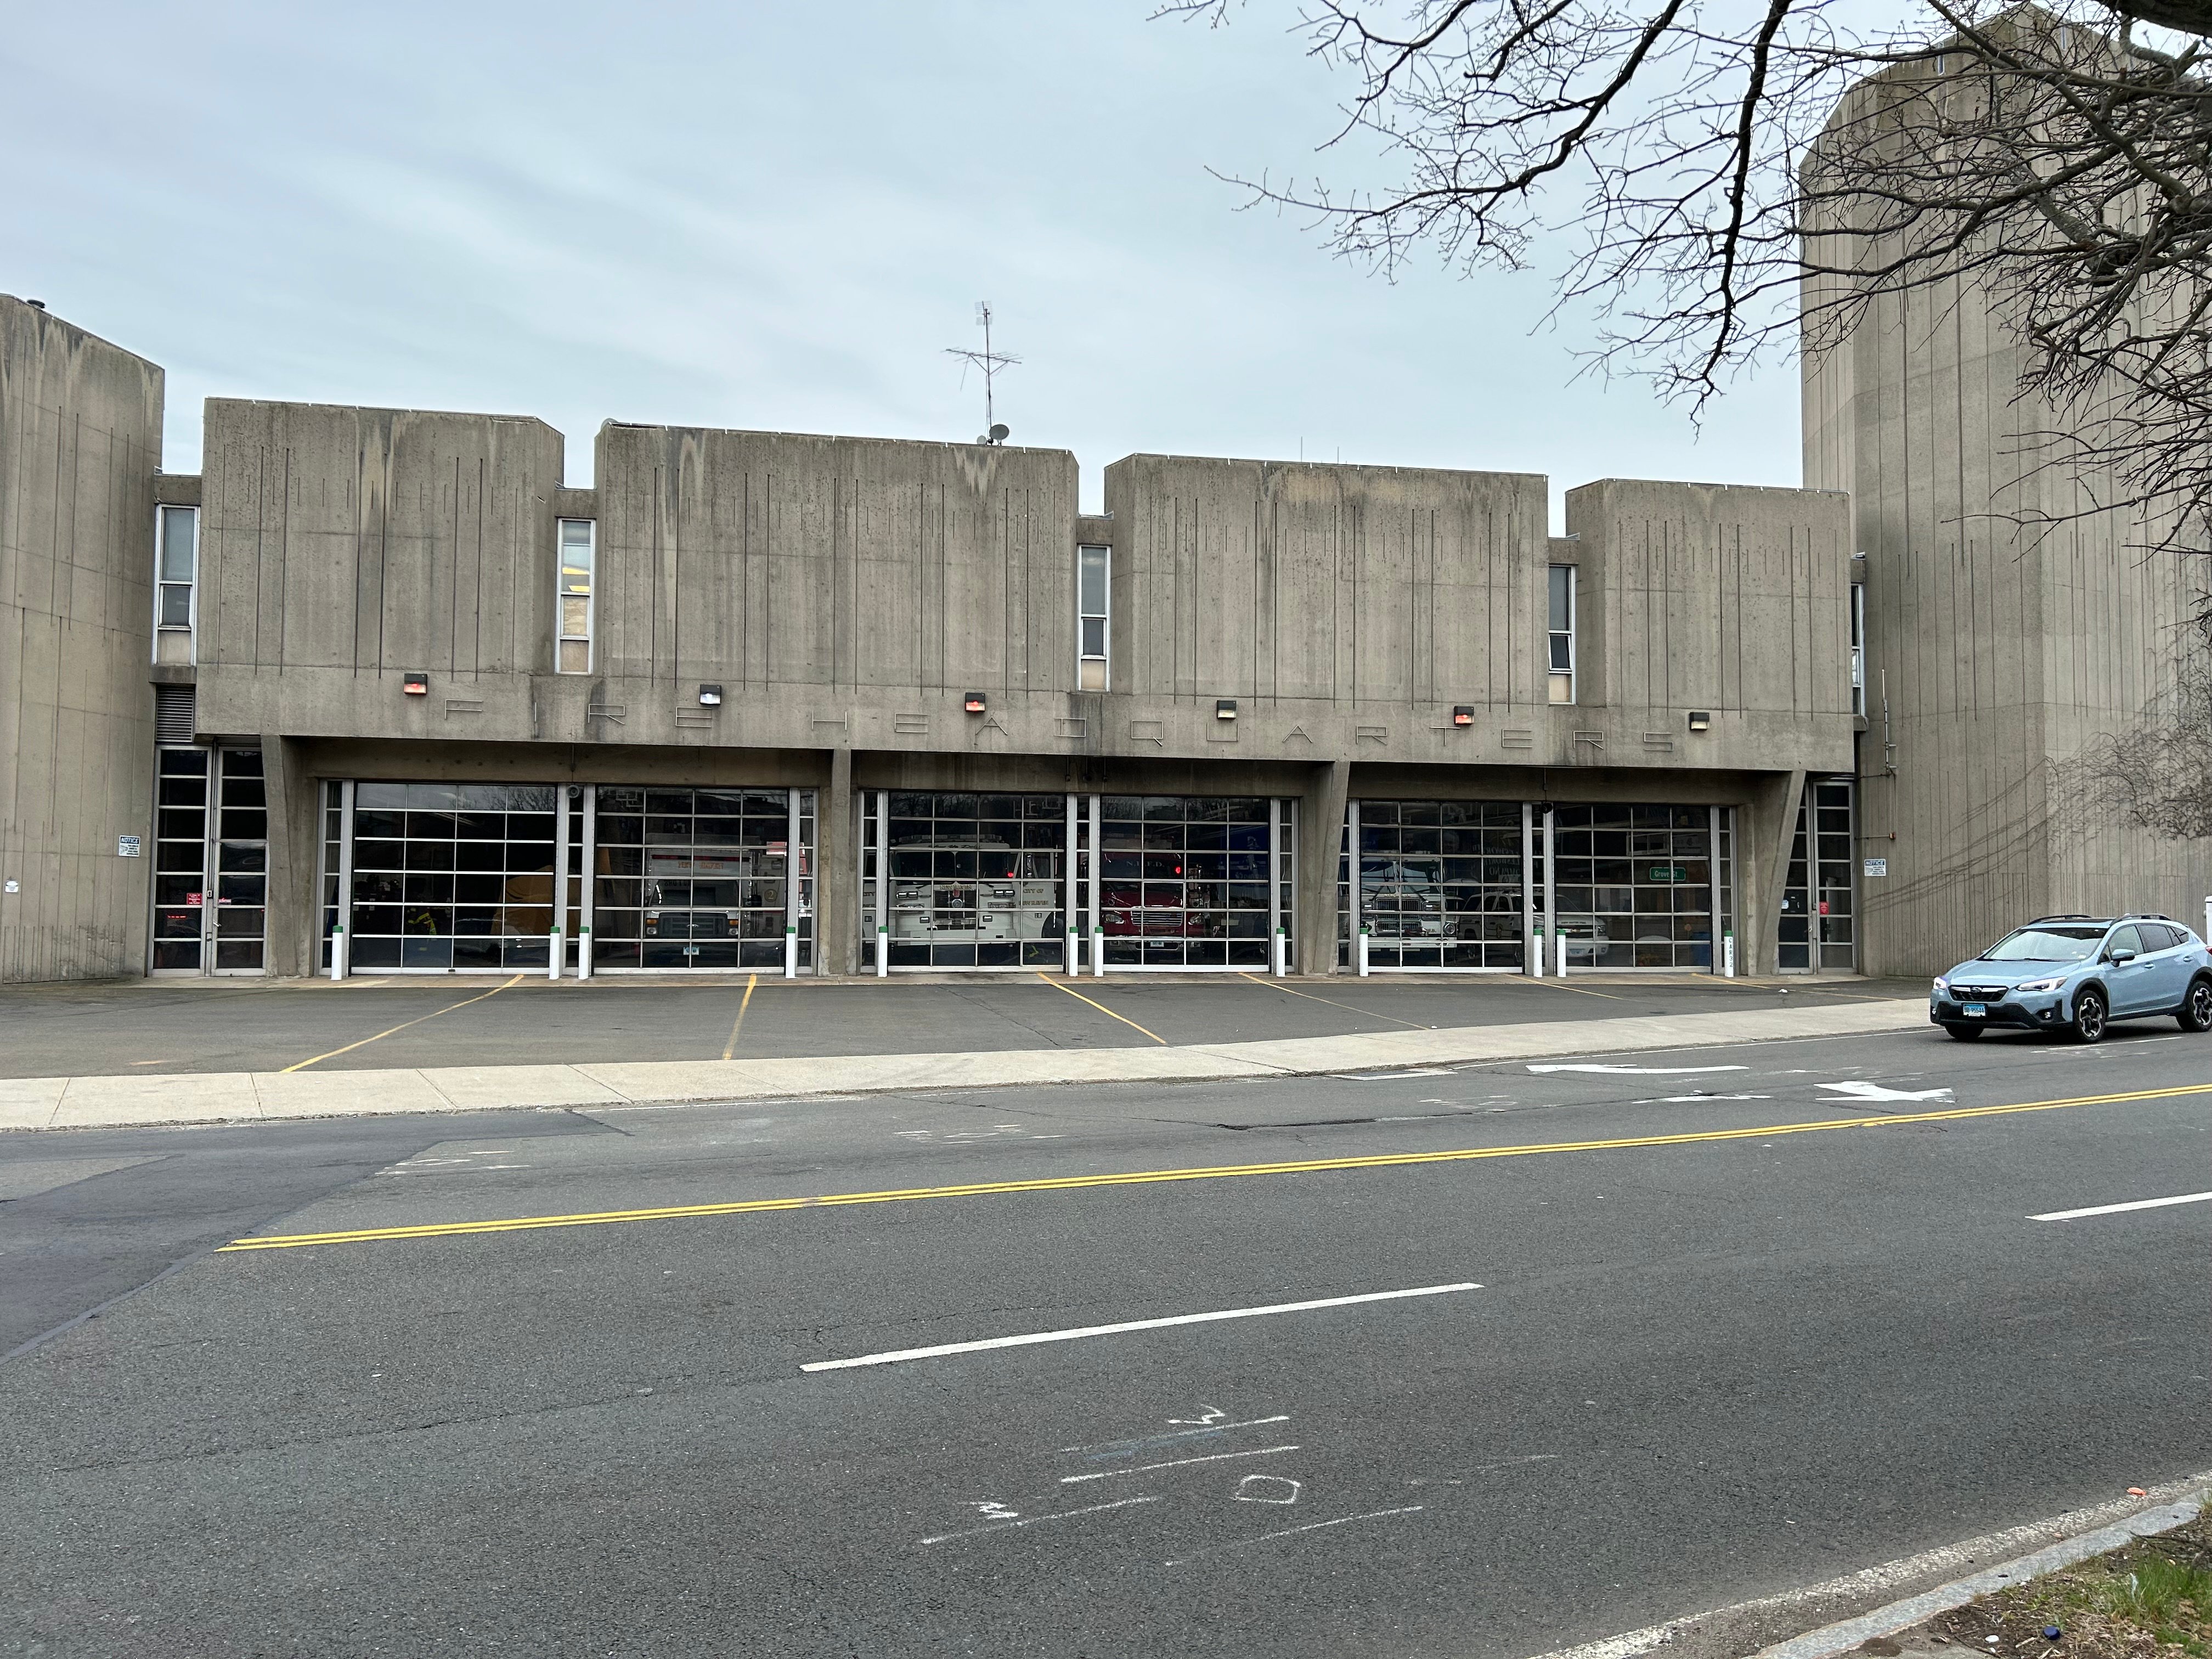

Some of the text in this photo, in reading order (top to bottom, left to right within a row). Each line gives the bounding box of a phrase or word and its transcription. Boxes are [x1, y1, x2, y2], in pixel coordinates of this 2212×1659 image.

[445, 699, 1674, 752] FIRE HEADQUARTERS
[768, 890, 774, 900] 2
